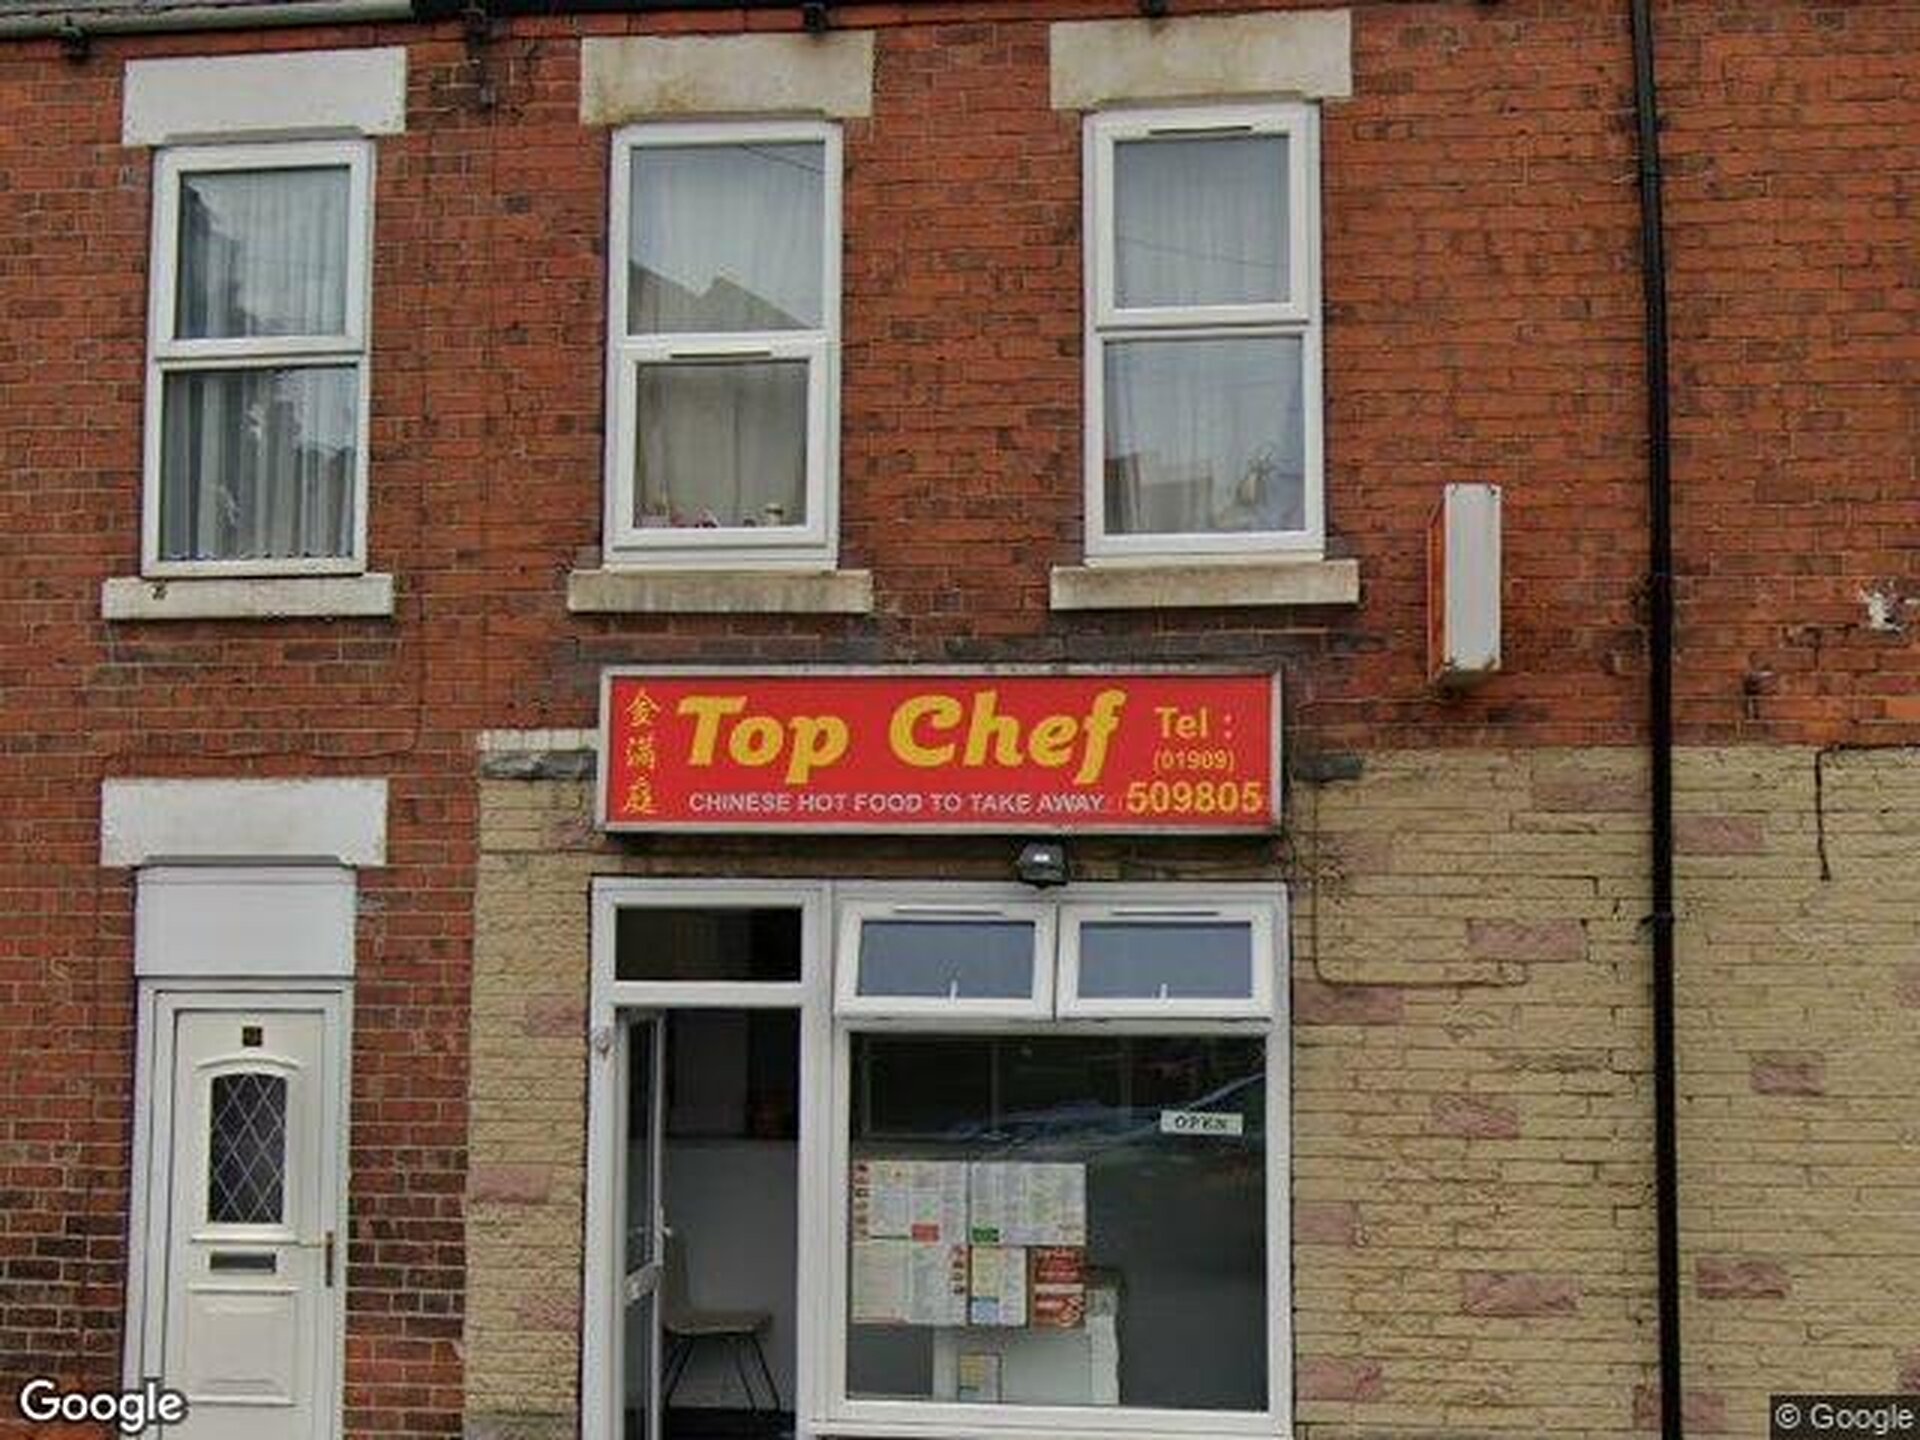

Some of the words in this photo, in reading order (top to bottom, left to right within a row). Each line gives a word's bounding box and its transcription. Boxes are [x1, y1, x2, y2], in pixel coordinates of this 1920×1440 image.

[677, 695, 849, 785] Top
[889, 688, 1127, 786] Chef
[1154, 706, 1208, 739] Tel
[1154, 748, 1236, 773] (01909)
[688, 793, 791, 813] CHINESE
[799, 793, 848, 813] HOT
[853, 793, 923, 813] FOOD
[930, 793, 962, 813] TO
[970, 793, 1031, 813] TAKE
[1036, 793, 1106, 813] AWAY
[1126, 780, 1264, 814] 509805
